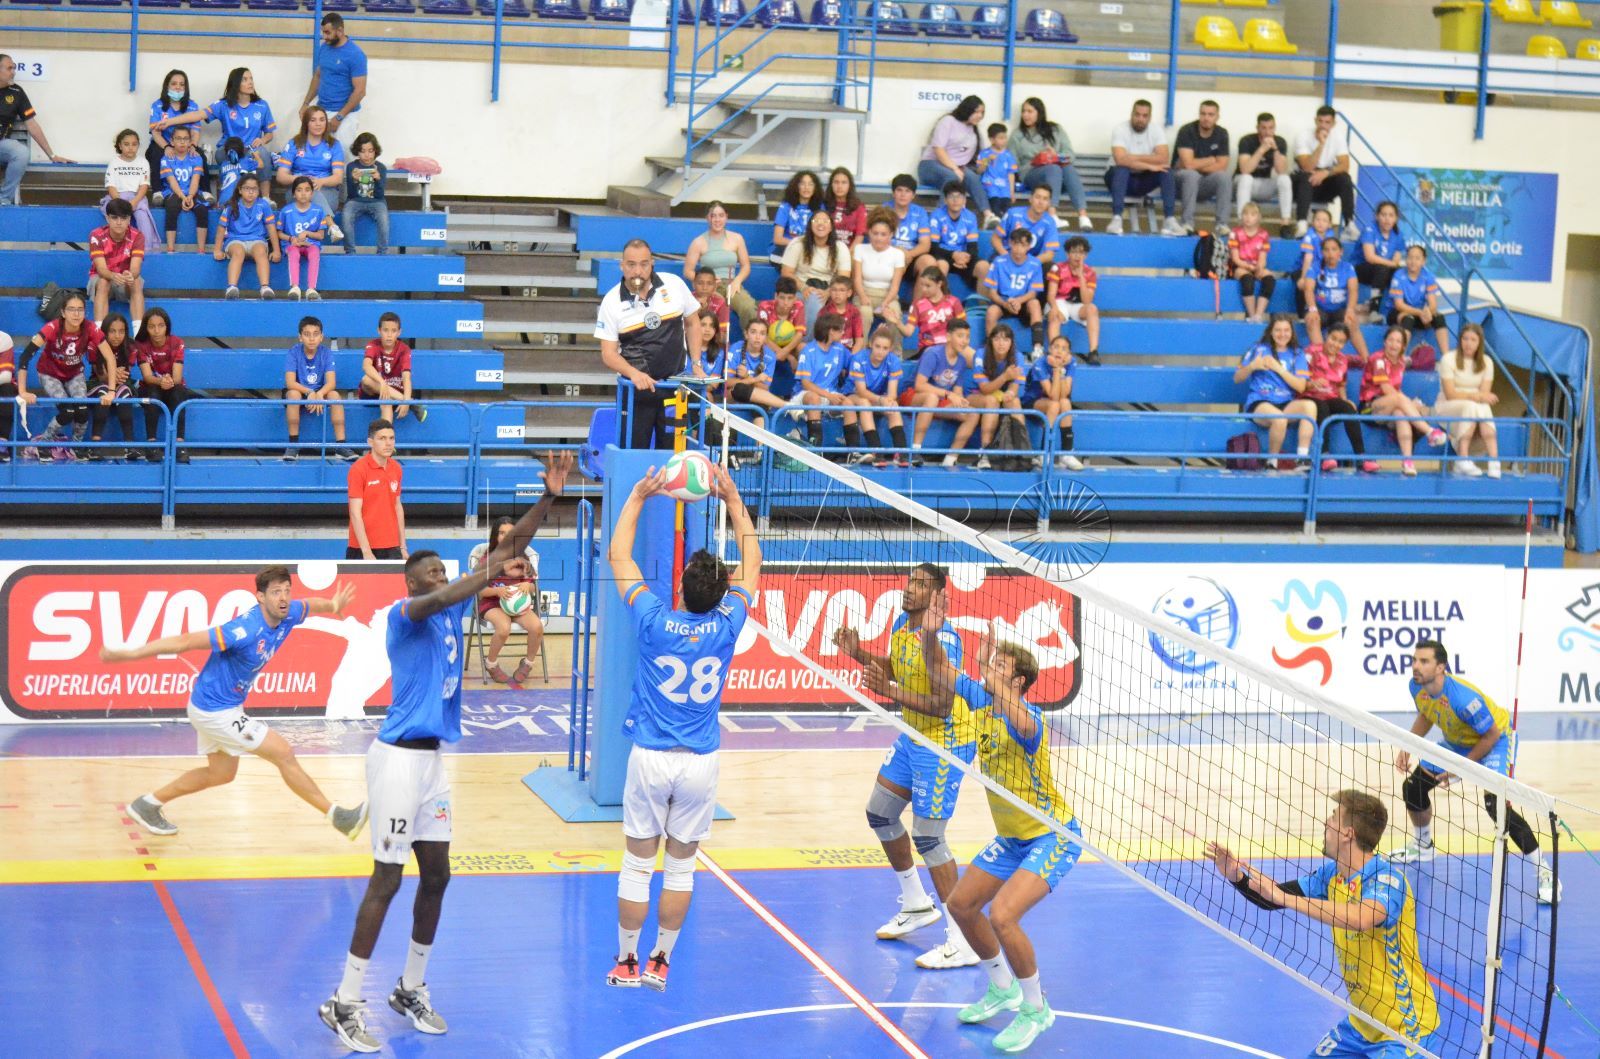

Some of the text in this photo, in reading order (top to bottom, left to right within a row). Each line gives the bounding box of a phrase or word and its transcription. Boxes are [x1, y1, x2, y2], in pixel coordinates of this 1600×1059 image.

[32, 62, 42, 76] 3
[918, 91, 962, 102] SECTOR
[243, 117, 250, 128] 1
[425, 174, 432, 182] 6
[1441, 190, 1502, 208] MELILLA
[440, 231, 445, 240] 5
[950, 232, 958, 244] 2
[1490, 240, 1523, 256] Ortiz
[456, 276, 462, 284] 4
[1009, 273, 1026, 290] 15
[928, 310, 946, 324] 24
[476, 322, 482, 330] 3
[824, 363, 832, 377] 7
[1362, 600, 1464, 621] MELILLA
[22, 674, 122, 696] SUPERLIGA
[126, 673, 200, 695] VOLEIBO
[653, 655, 722, 704] 28
[232, 715, 250, 734] 24
[390, 818, 408, 834] 12
